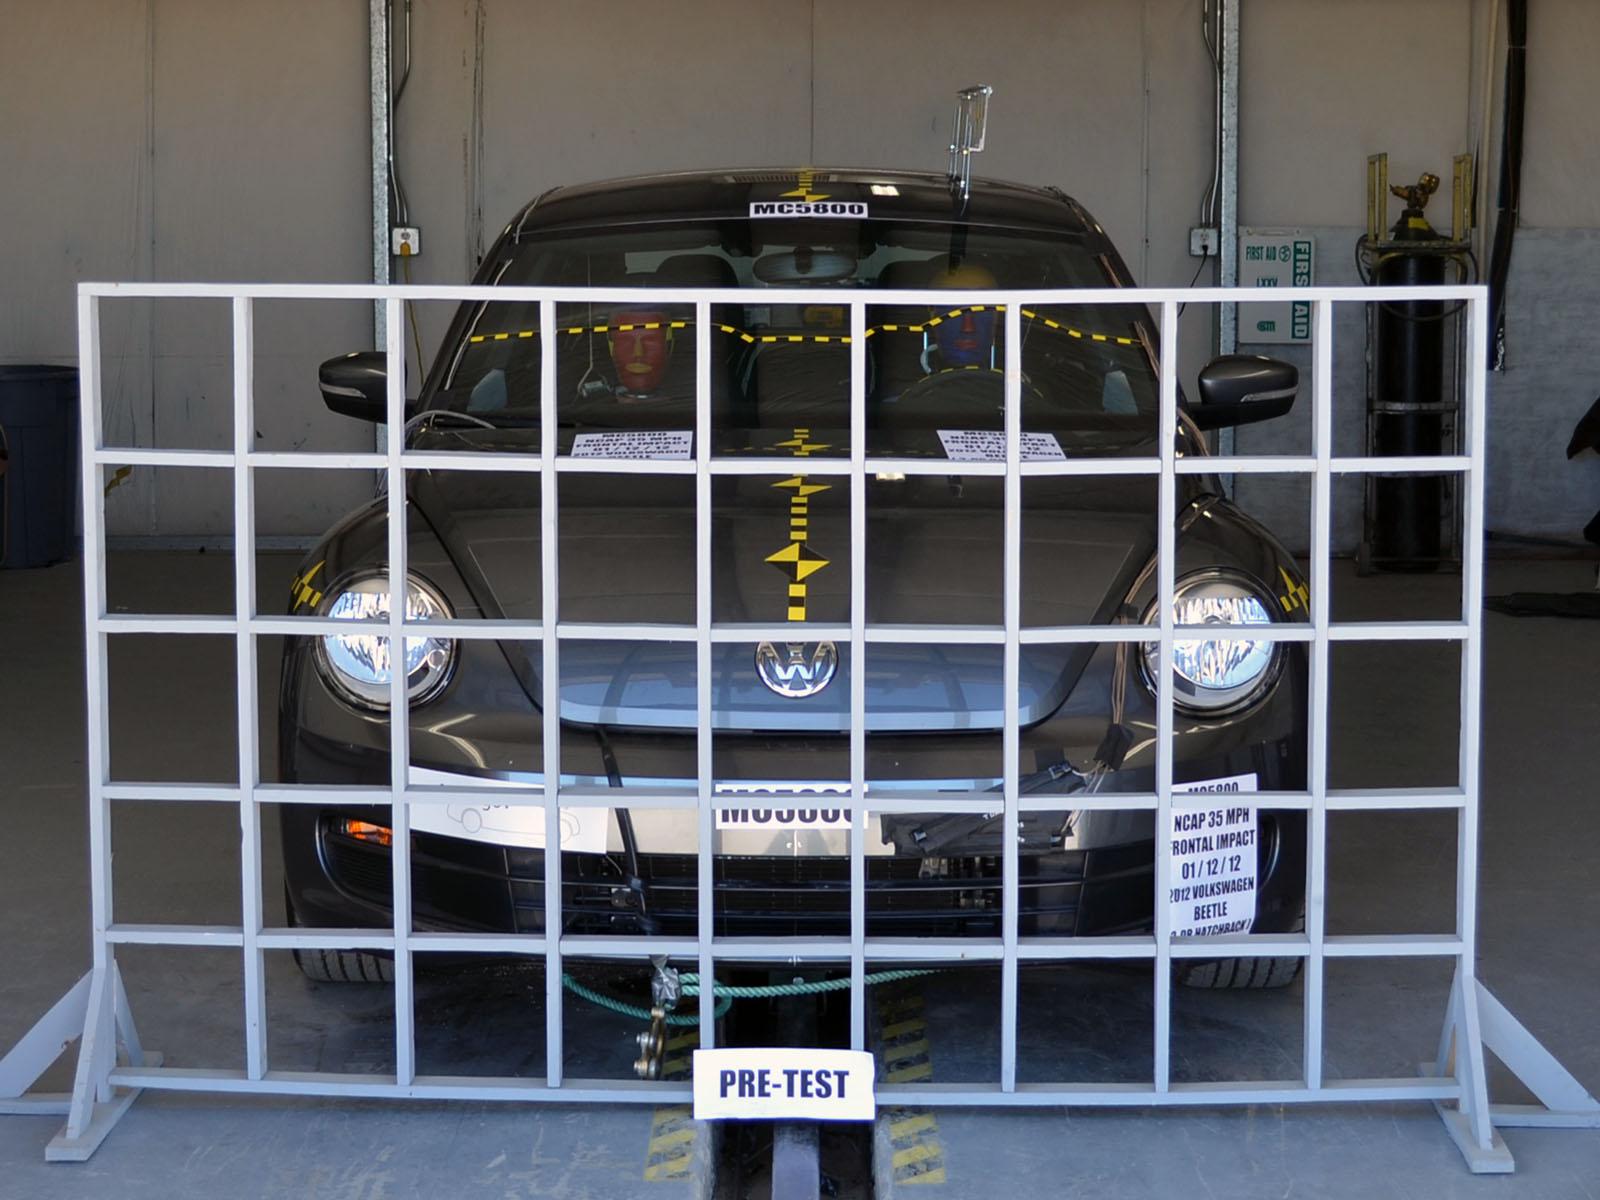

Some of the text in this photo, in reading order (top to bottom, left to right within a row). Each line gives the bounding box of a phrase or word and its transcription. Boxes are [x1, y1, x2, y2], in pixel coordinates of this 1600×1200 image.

[753, 203, 864, 215] MC5800
[1246, 246, 1264, 260] FIRST
[1294, 243, 1309, 337] FIRS AID
[1174, 808, 1249, 832] NCAP 35 MPH
[1171, 830, 1255, 856] RONTAL IMPACT
[1182, 862, 1196, 879] 01
[1206, 858, 1218, 876] 12
[1229, 855, 1241, 872] 12
[1193, 876, 1254, 899] VOLKSWAGEN
[1194, 901, 1227, 920] BEETLE
[720, 1069, 850, 1098] PRE-TEST
